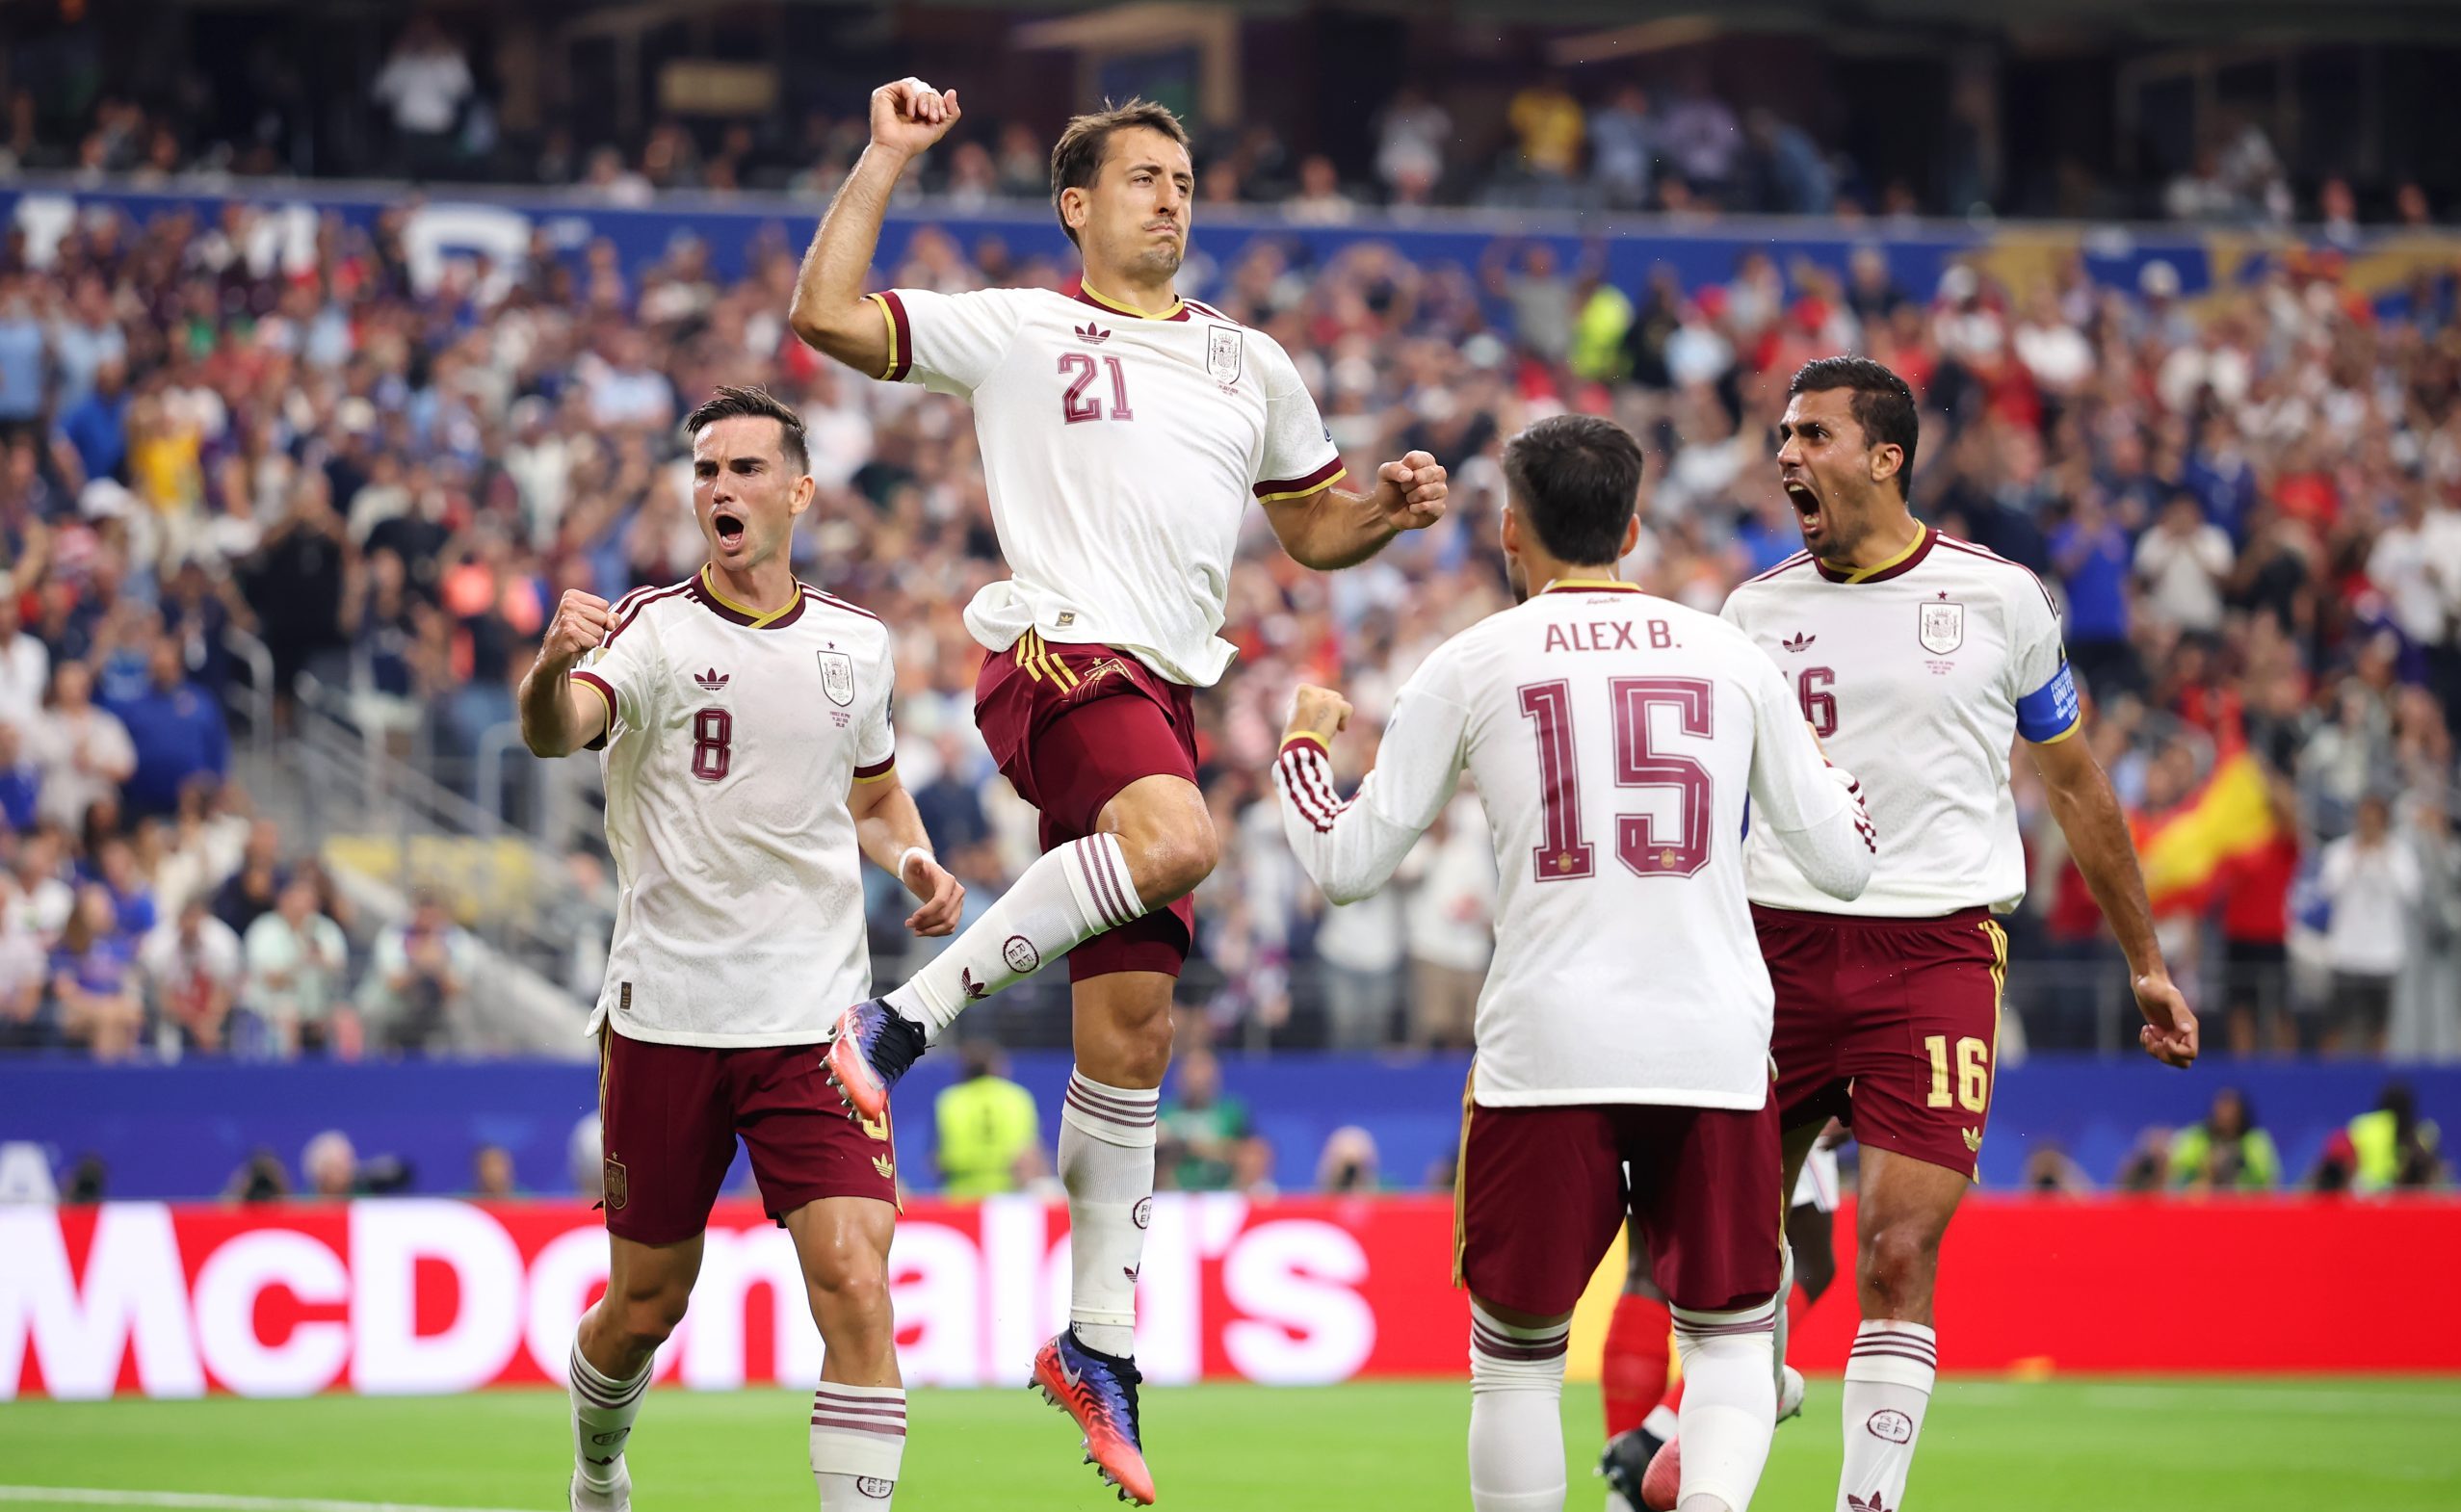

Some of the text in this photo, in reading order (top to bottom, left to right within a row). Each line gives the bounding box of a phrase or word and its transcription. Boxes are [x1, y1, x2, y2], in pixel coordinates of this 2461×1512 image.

[1058, 352, 1134, 425] 21
[1544, 619, 1683, 653] ALEX B.
[1782, 666, 1838, 739] 6
[691, 707, 732, 782] 8
[1517, 676, 1713, 882] 15
[1924, 1034, 1988, 1114] 16
